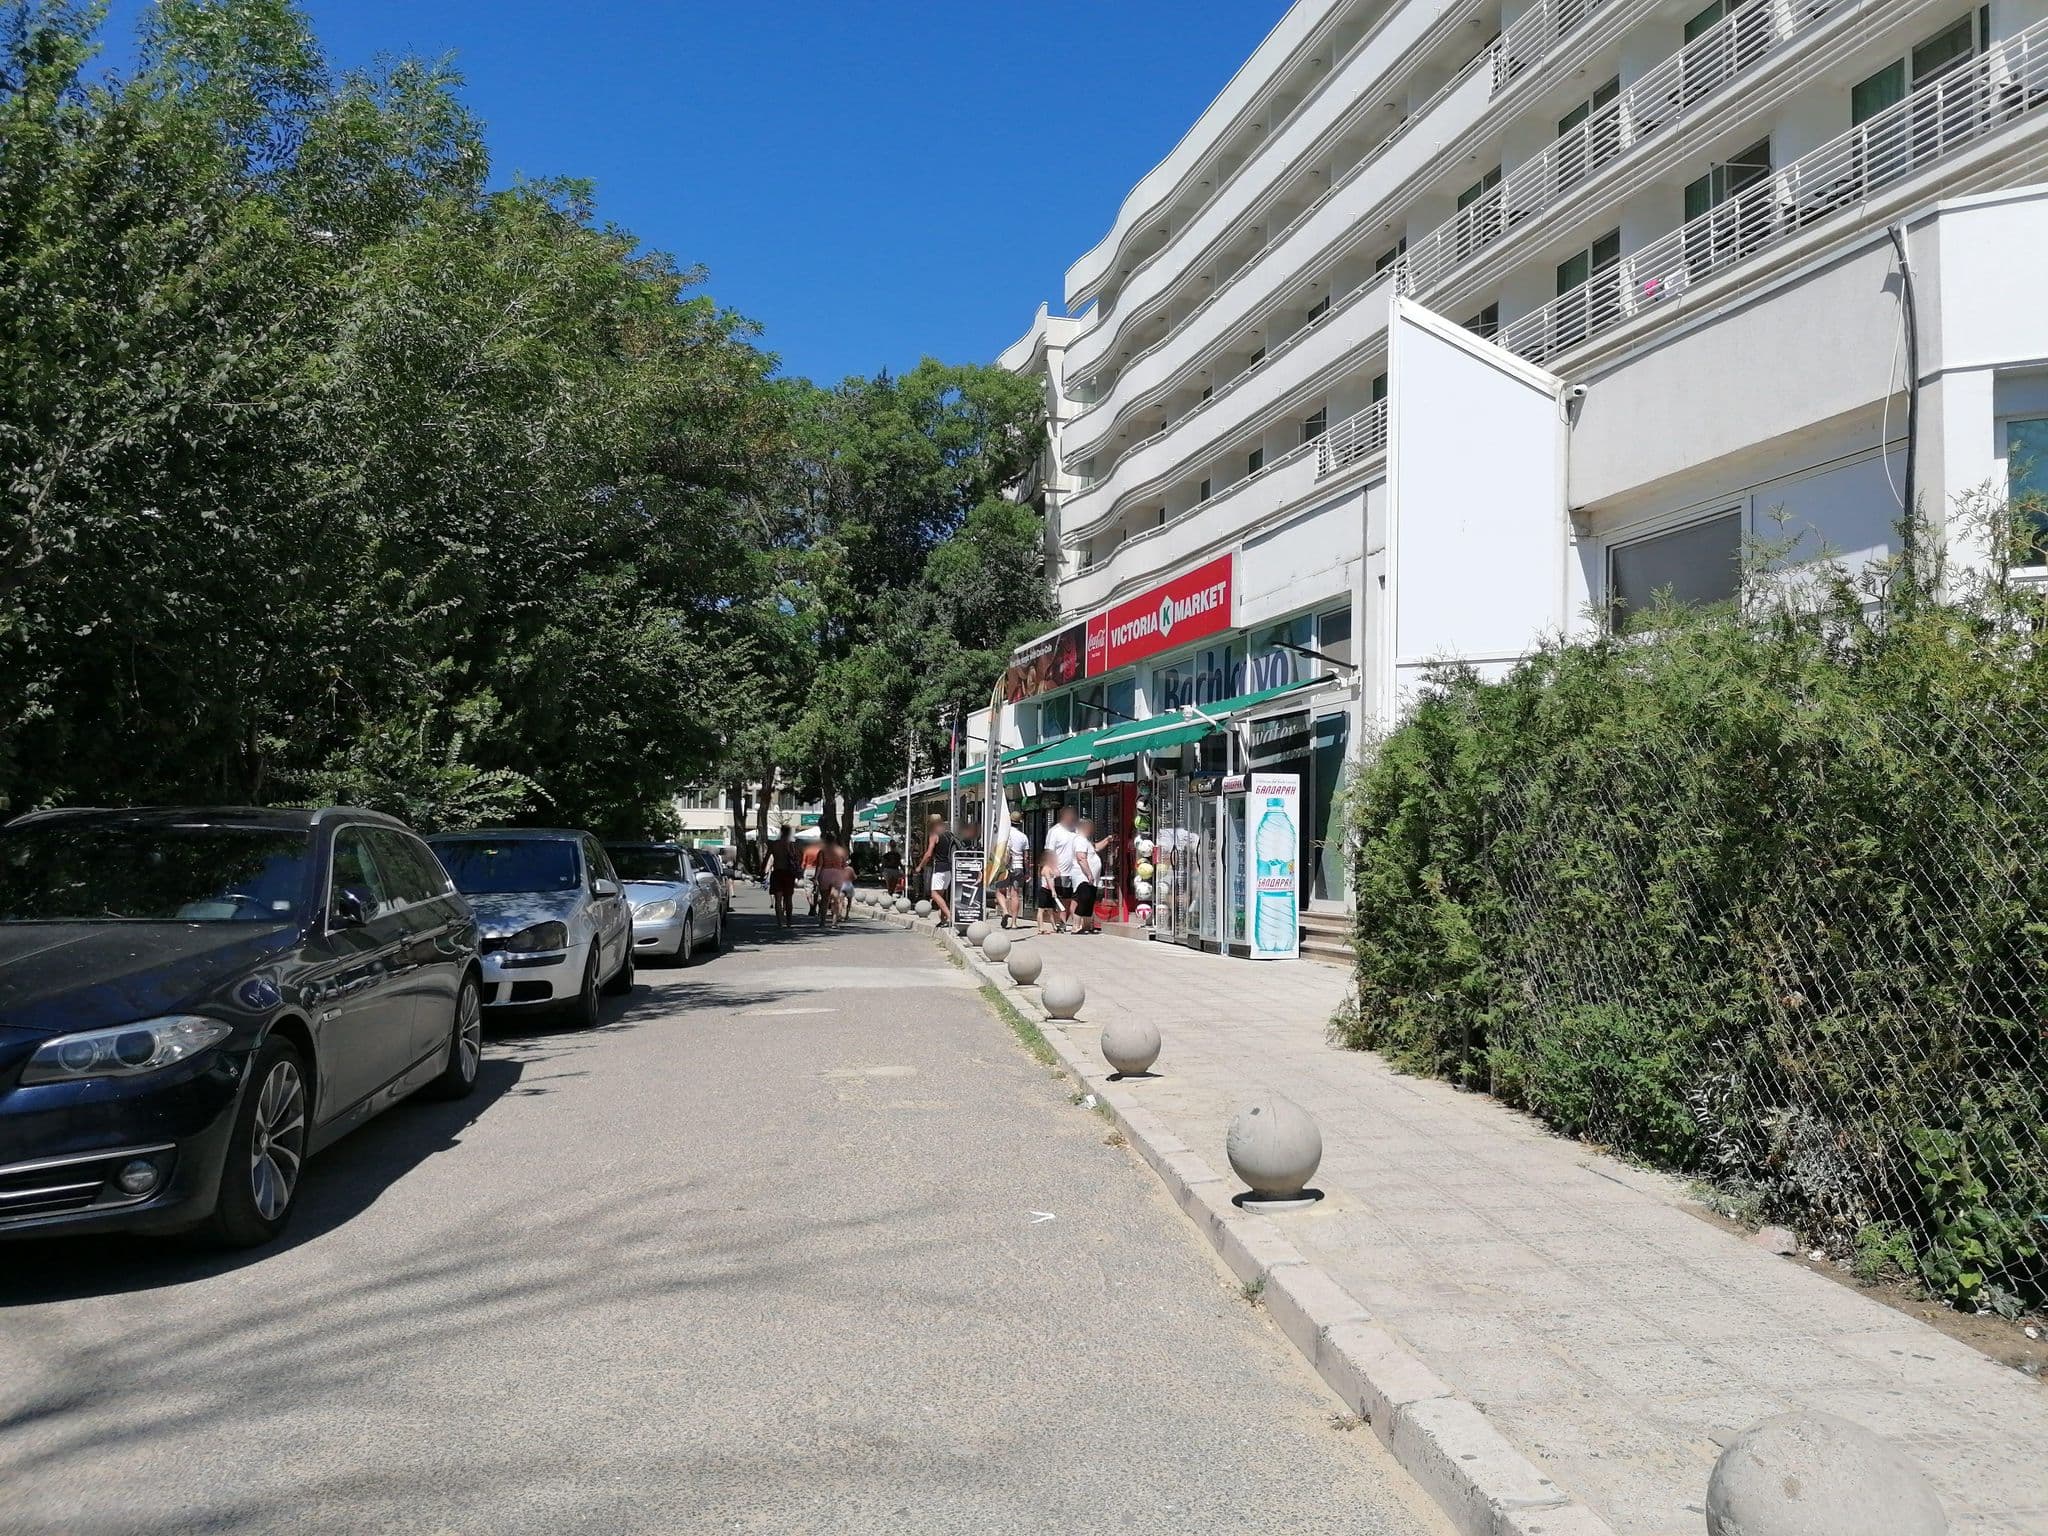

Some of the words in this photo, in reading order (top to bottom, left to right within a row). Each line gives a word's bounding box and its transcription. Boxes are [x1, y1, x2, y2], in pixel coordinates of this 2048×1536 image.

[1111, 611, 1158, 648] VICTORIA
[1174, 581, 1227, 624] MARKET
[1255, 785, 1297, 795] БАЛДАРАН
